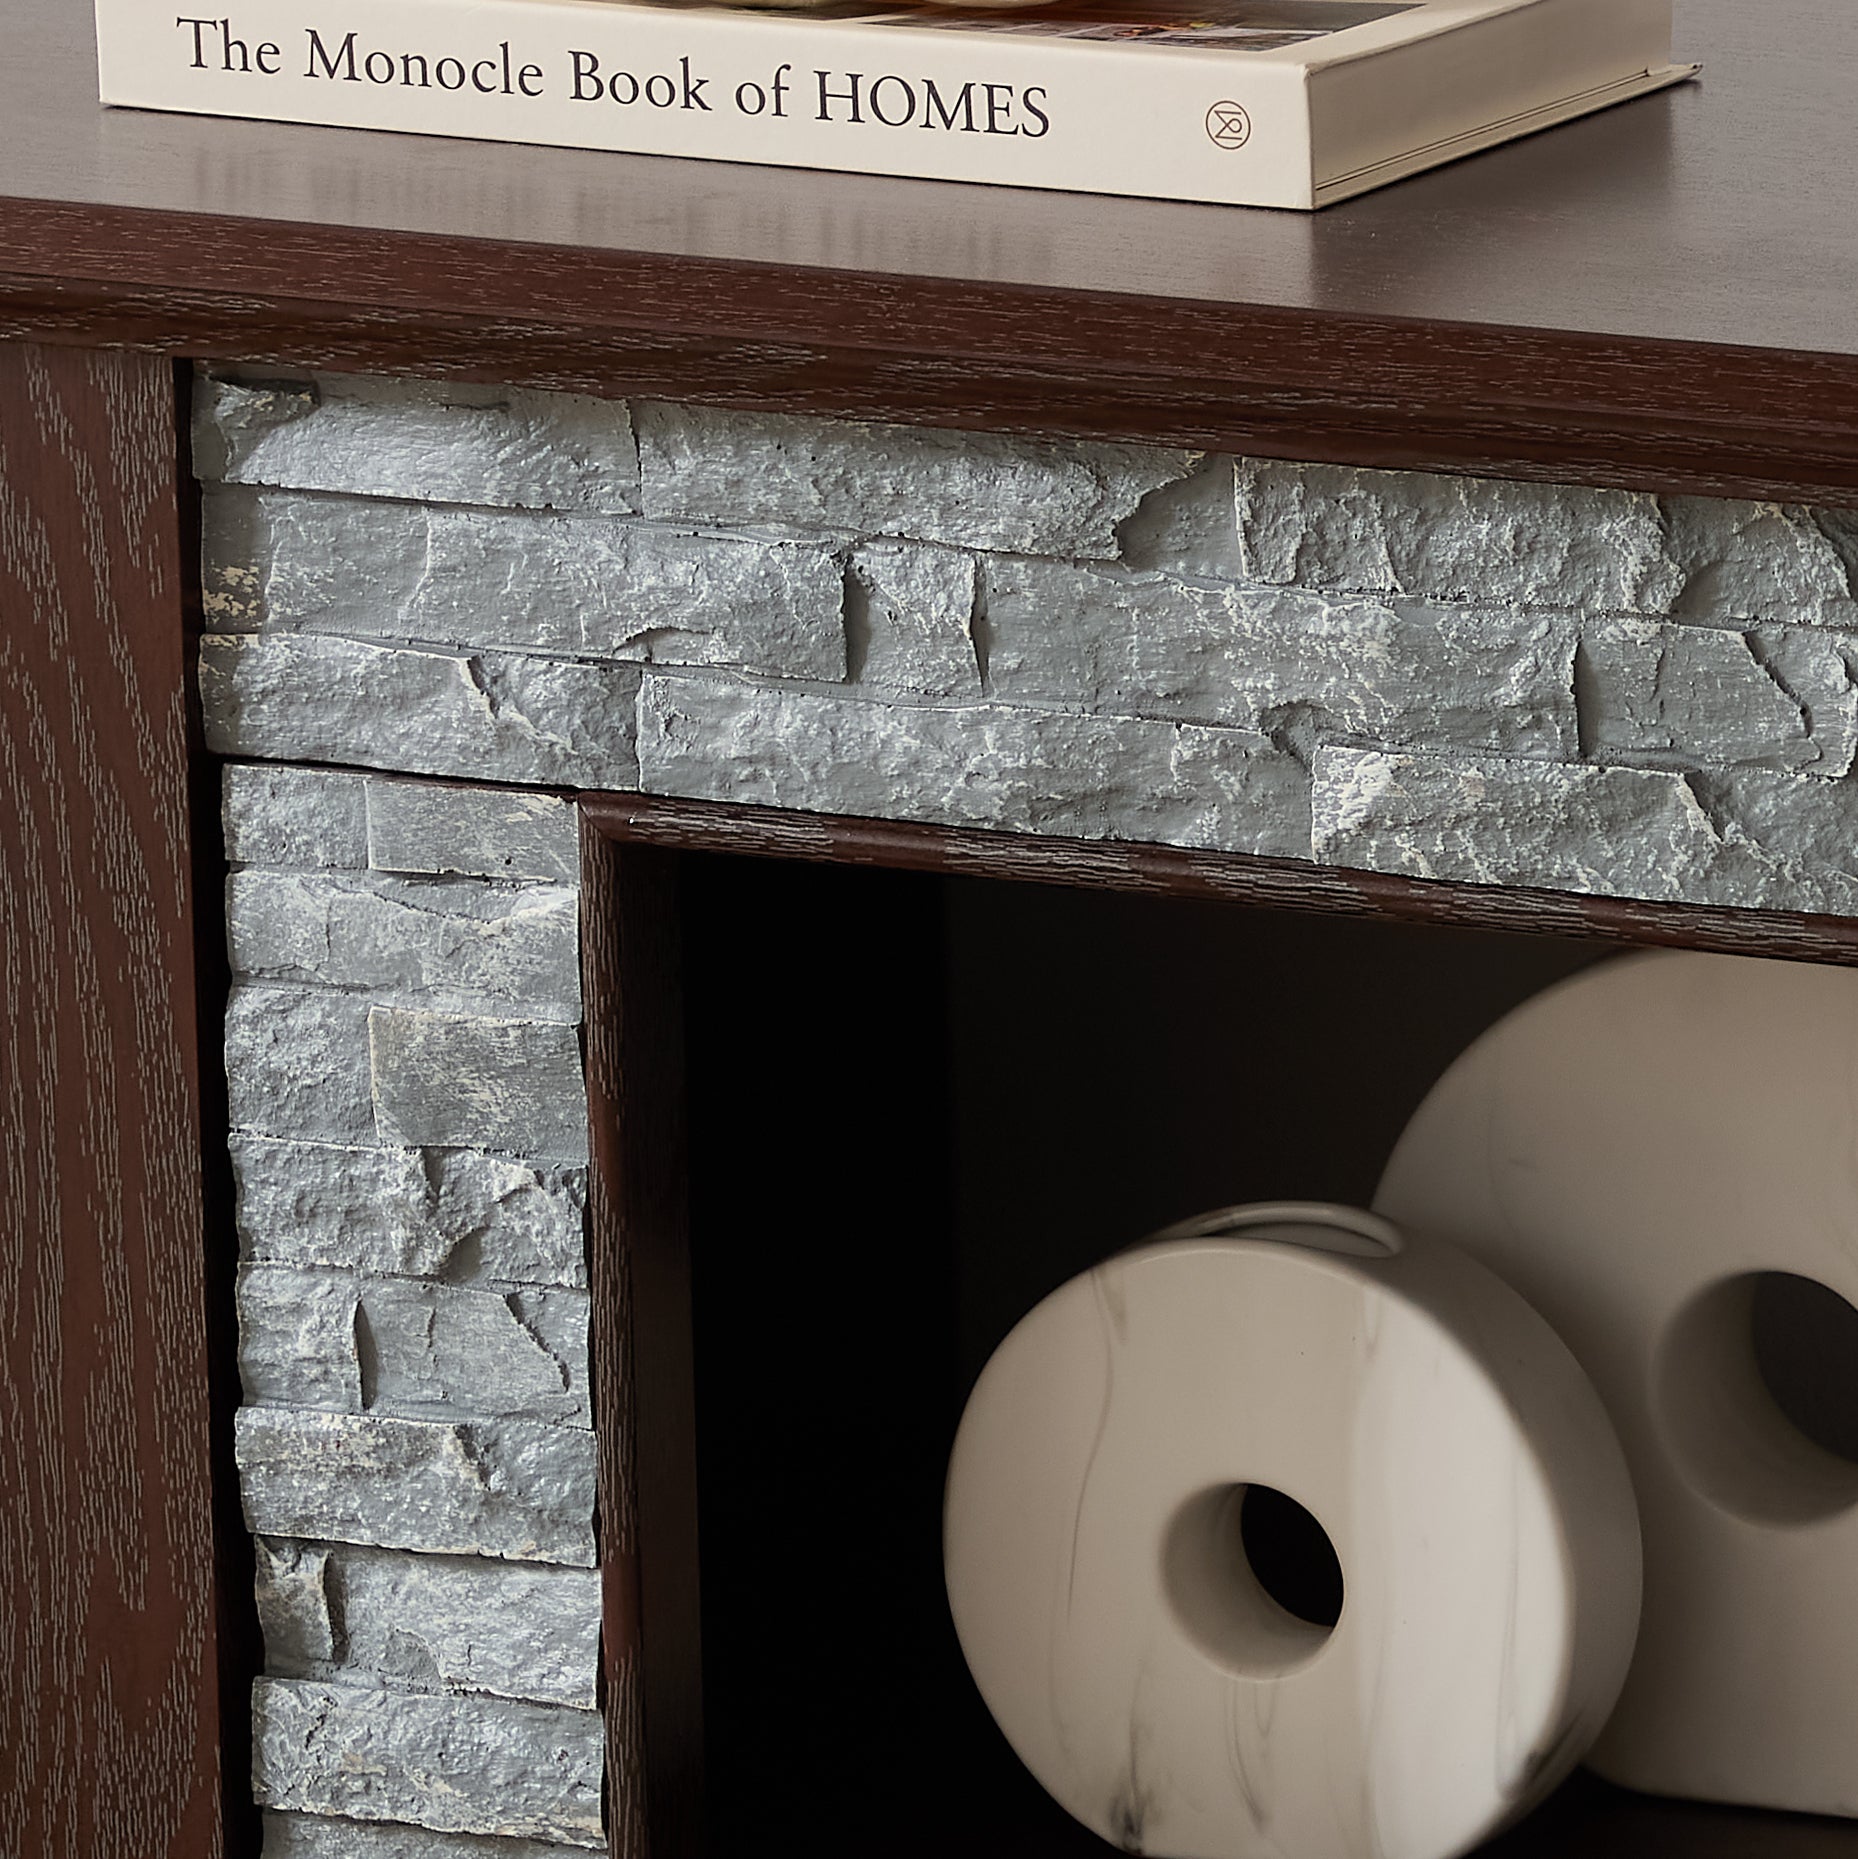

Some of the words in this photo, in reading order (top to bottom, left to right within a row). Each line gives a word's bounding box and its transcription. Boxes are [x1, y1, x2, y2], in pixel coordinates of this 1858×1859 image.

[176, 16, 281, 75] The
[303, 28, 544, 97] Monocle
[567, 50, 713, 112] Book
[735, 63, 792, 118] of
[812, 70, 1050, 138] HOMES
